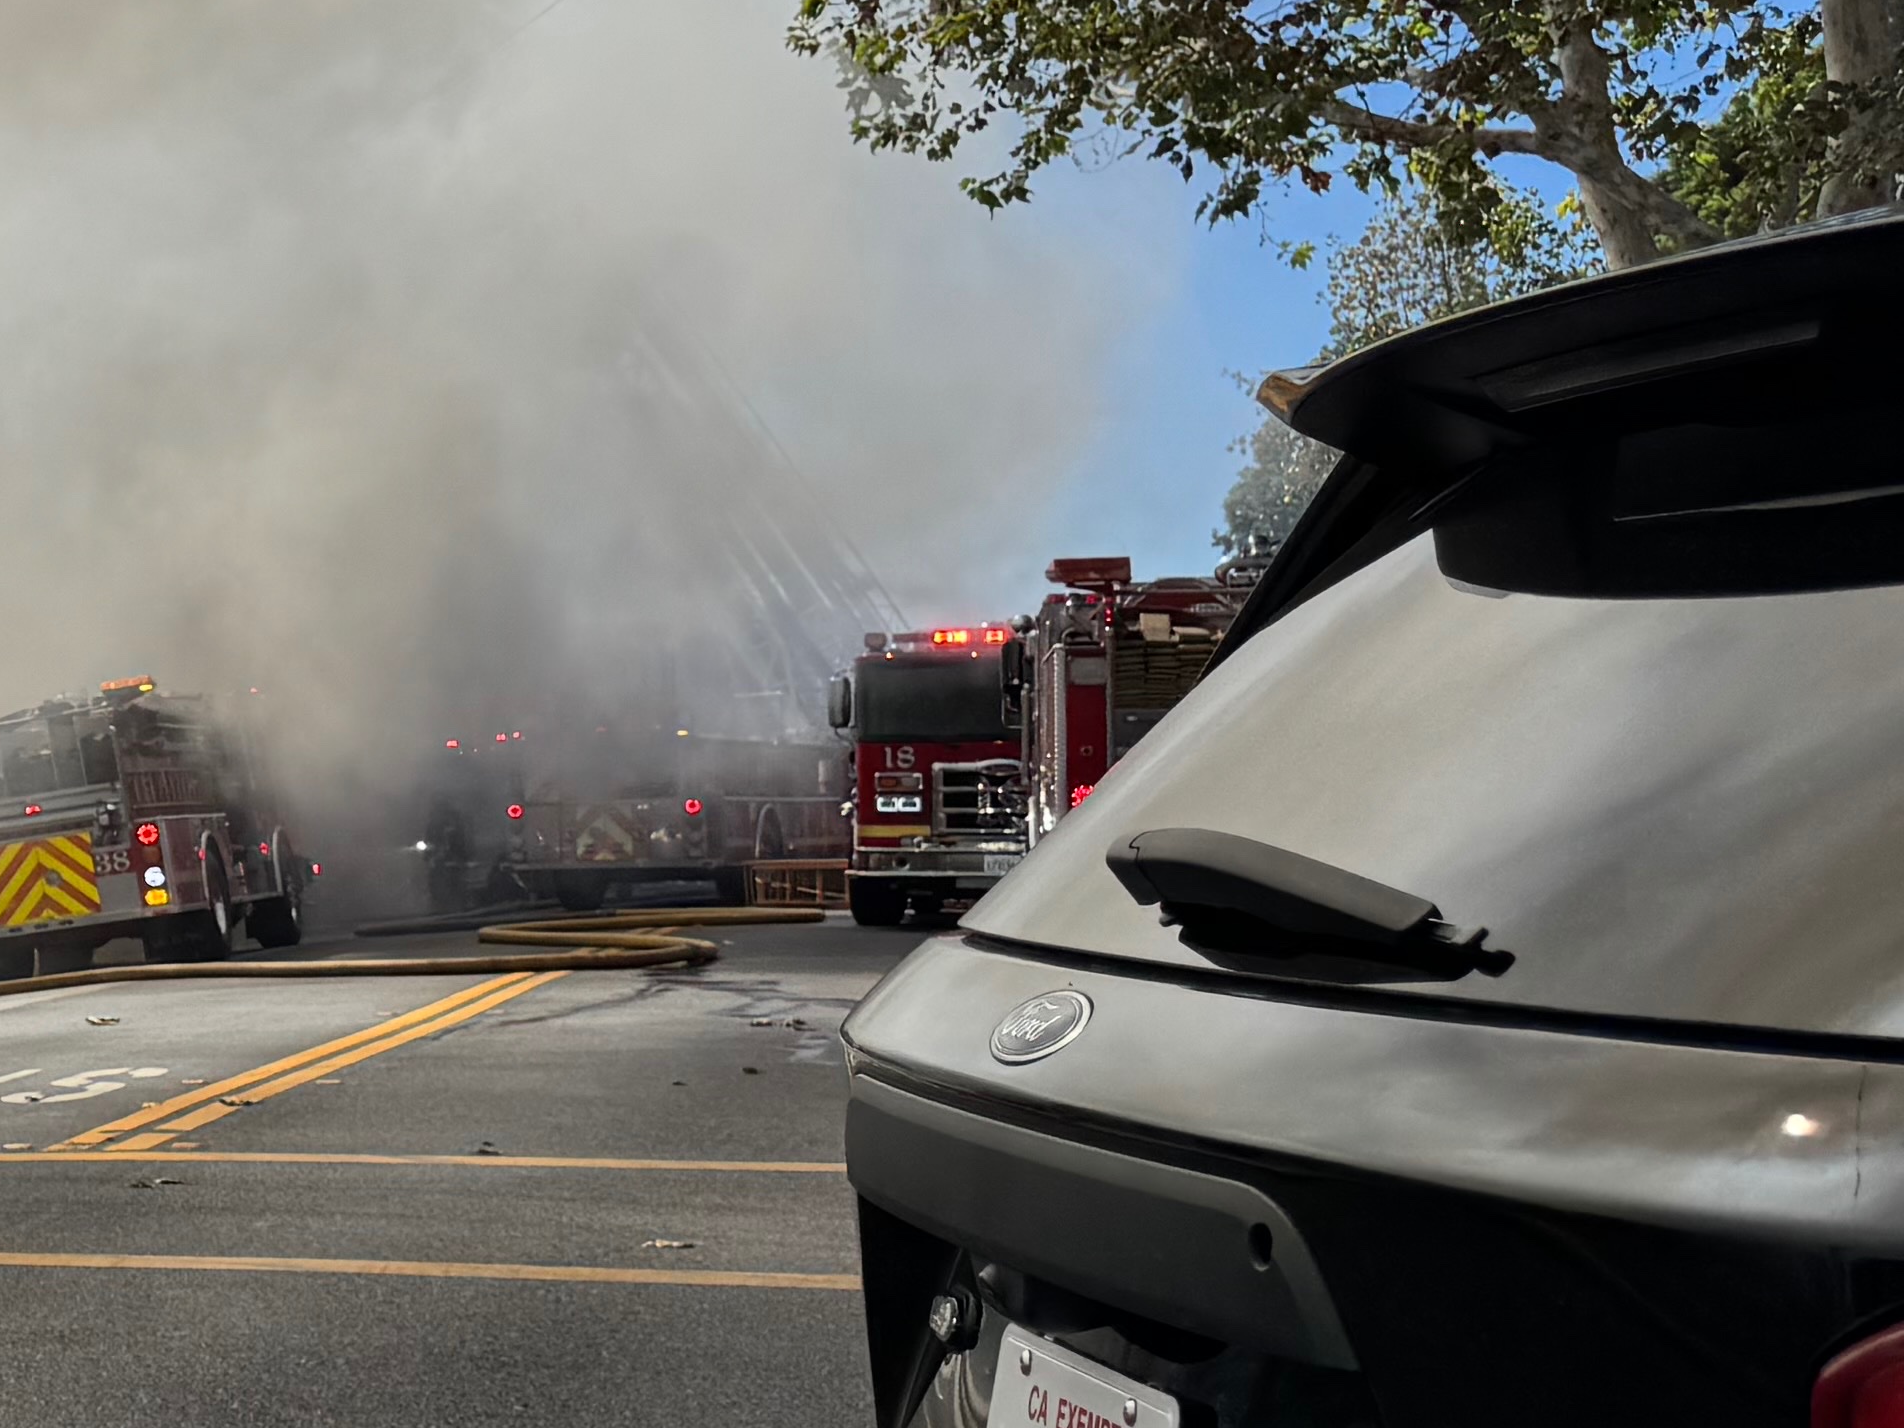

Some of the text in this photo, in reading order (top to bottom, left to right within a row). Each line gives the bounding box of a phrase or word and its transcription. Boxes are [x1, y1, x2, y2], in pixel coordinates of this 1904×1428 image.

[884, 746, 915, 768] 18
[95, 850, 130, 873] 38
[1002, 999, 1062, 1041] Ford
[1027, 1385, 1049, 1424] CA
